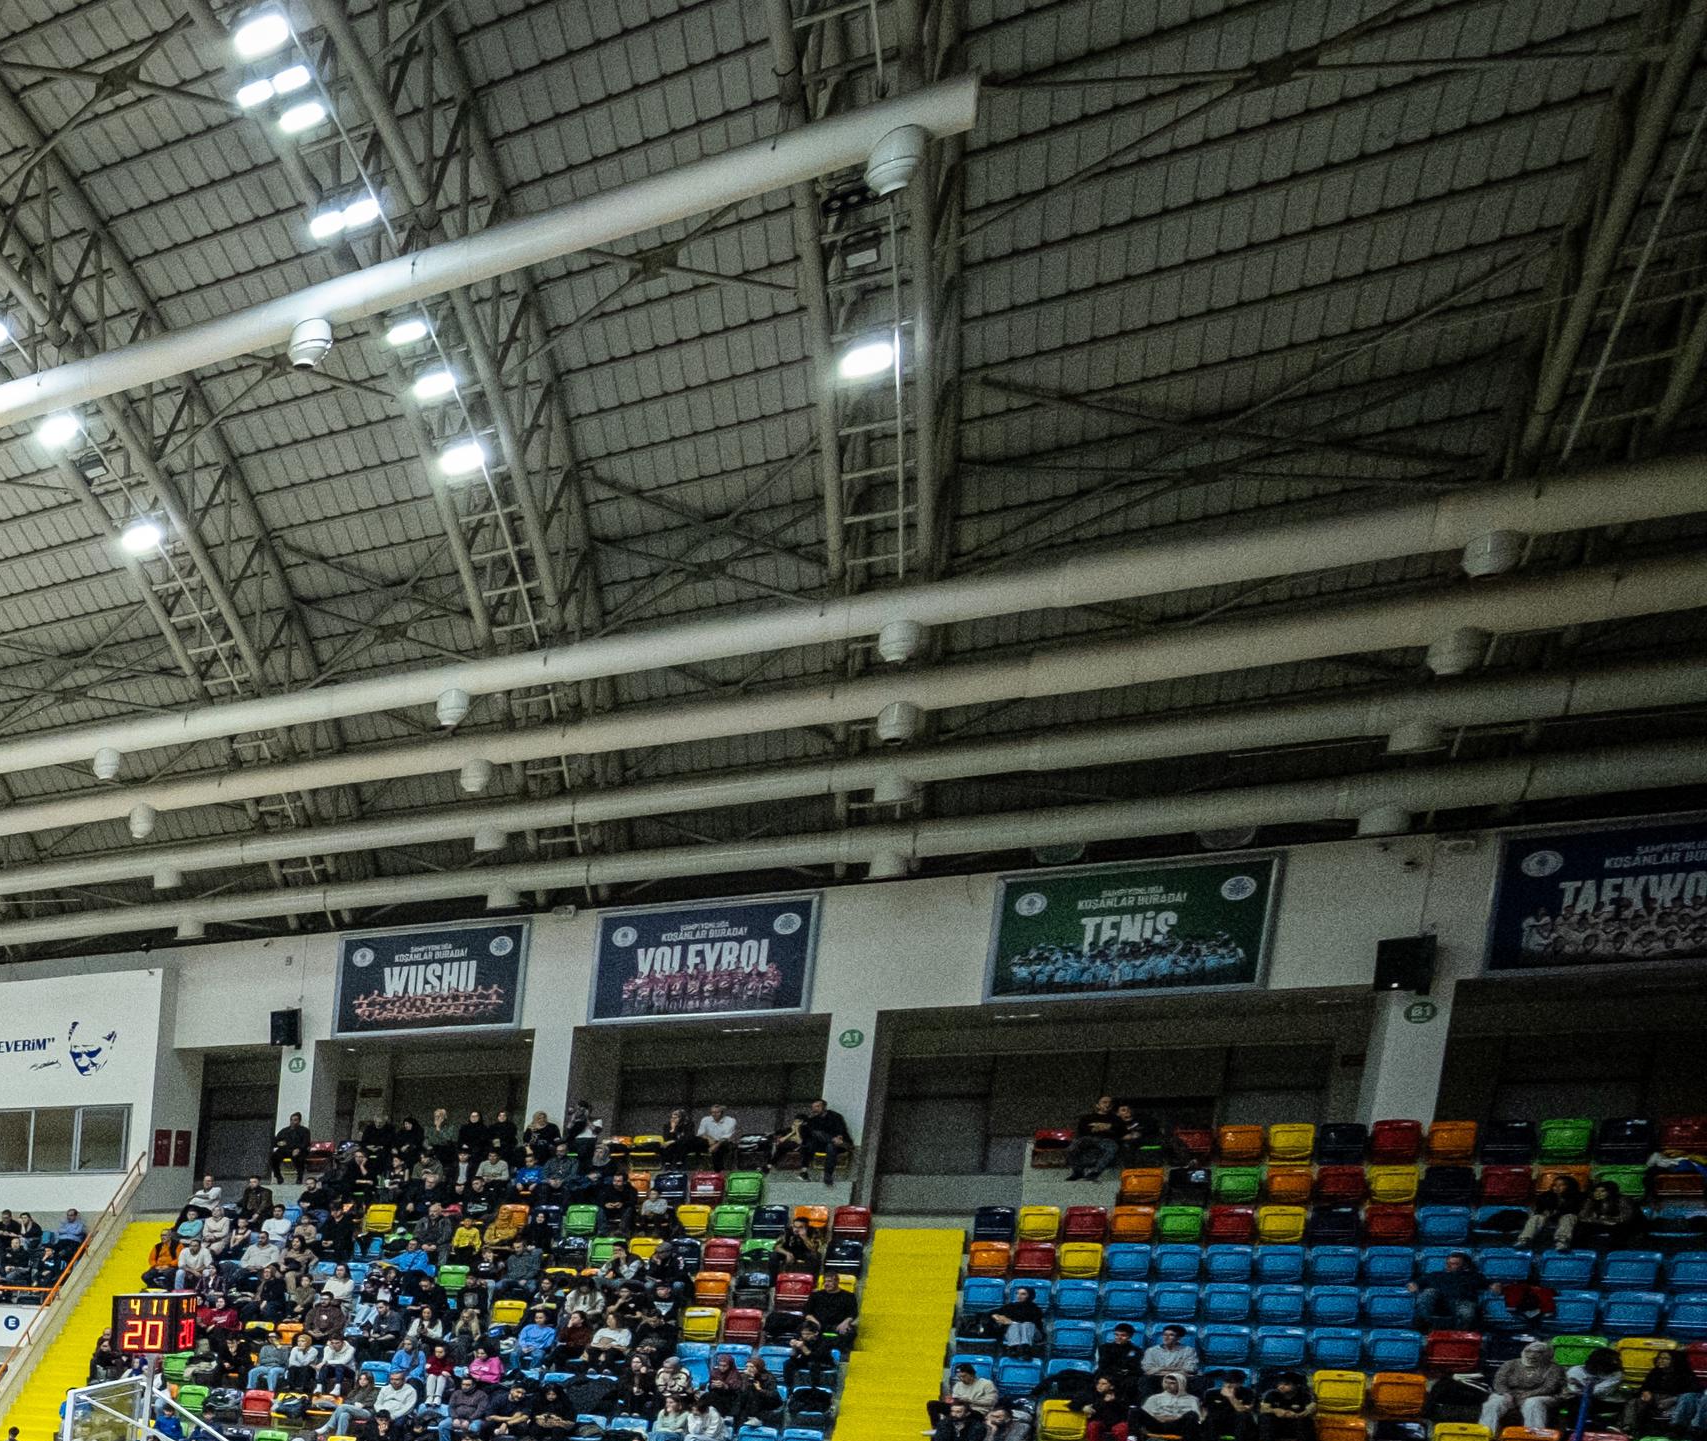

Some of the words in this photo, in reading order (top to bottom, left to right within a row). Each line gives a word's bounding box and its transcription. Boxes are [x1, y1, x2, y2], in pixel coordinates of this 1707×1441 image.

[1080, 911, 1178, 954] TENİS
[383, 960, 477, 997] WUSHU
[8, 1318, 17, 1327] E
[131, 1299, 140, 1316] 4
[123, 1320, 164, 1350] 20
[178, 1318, 195, 1348] 20
